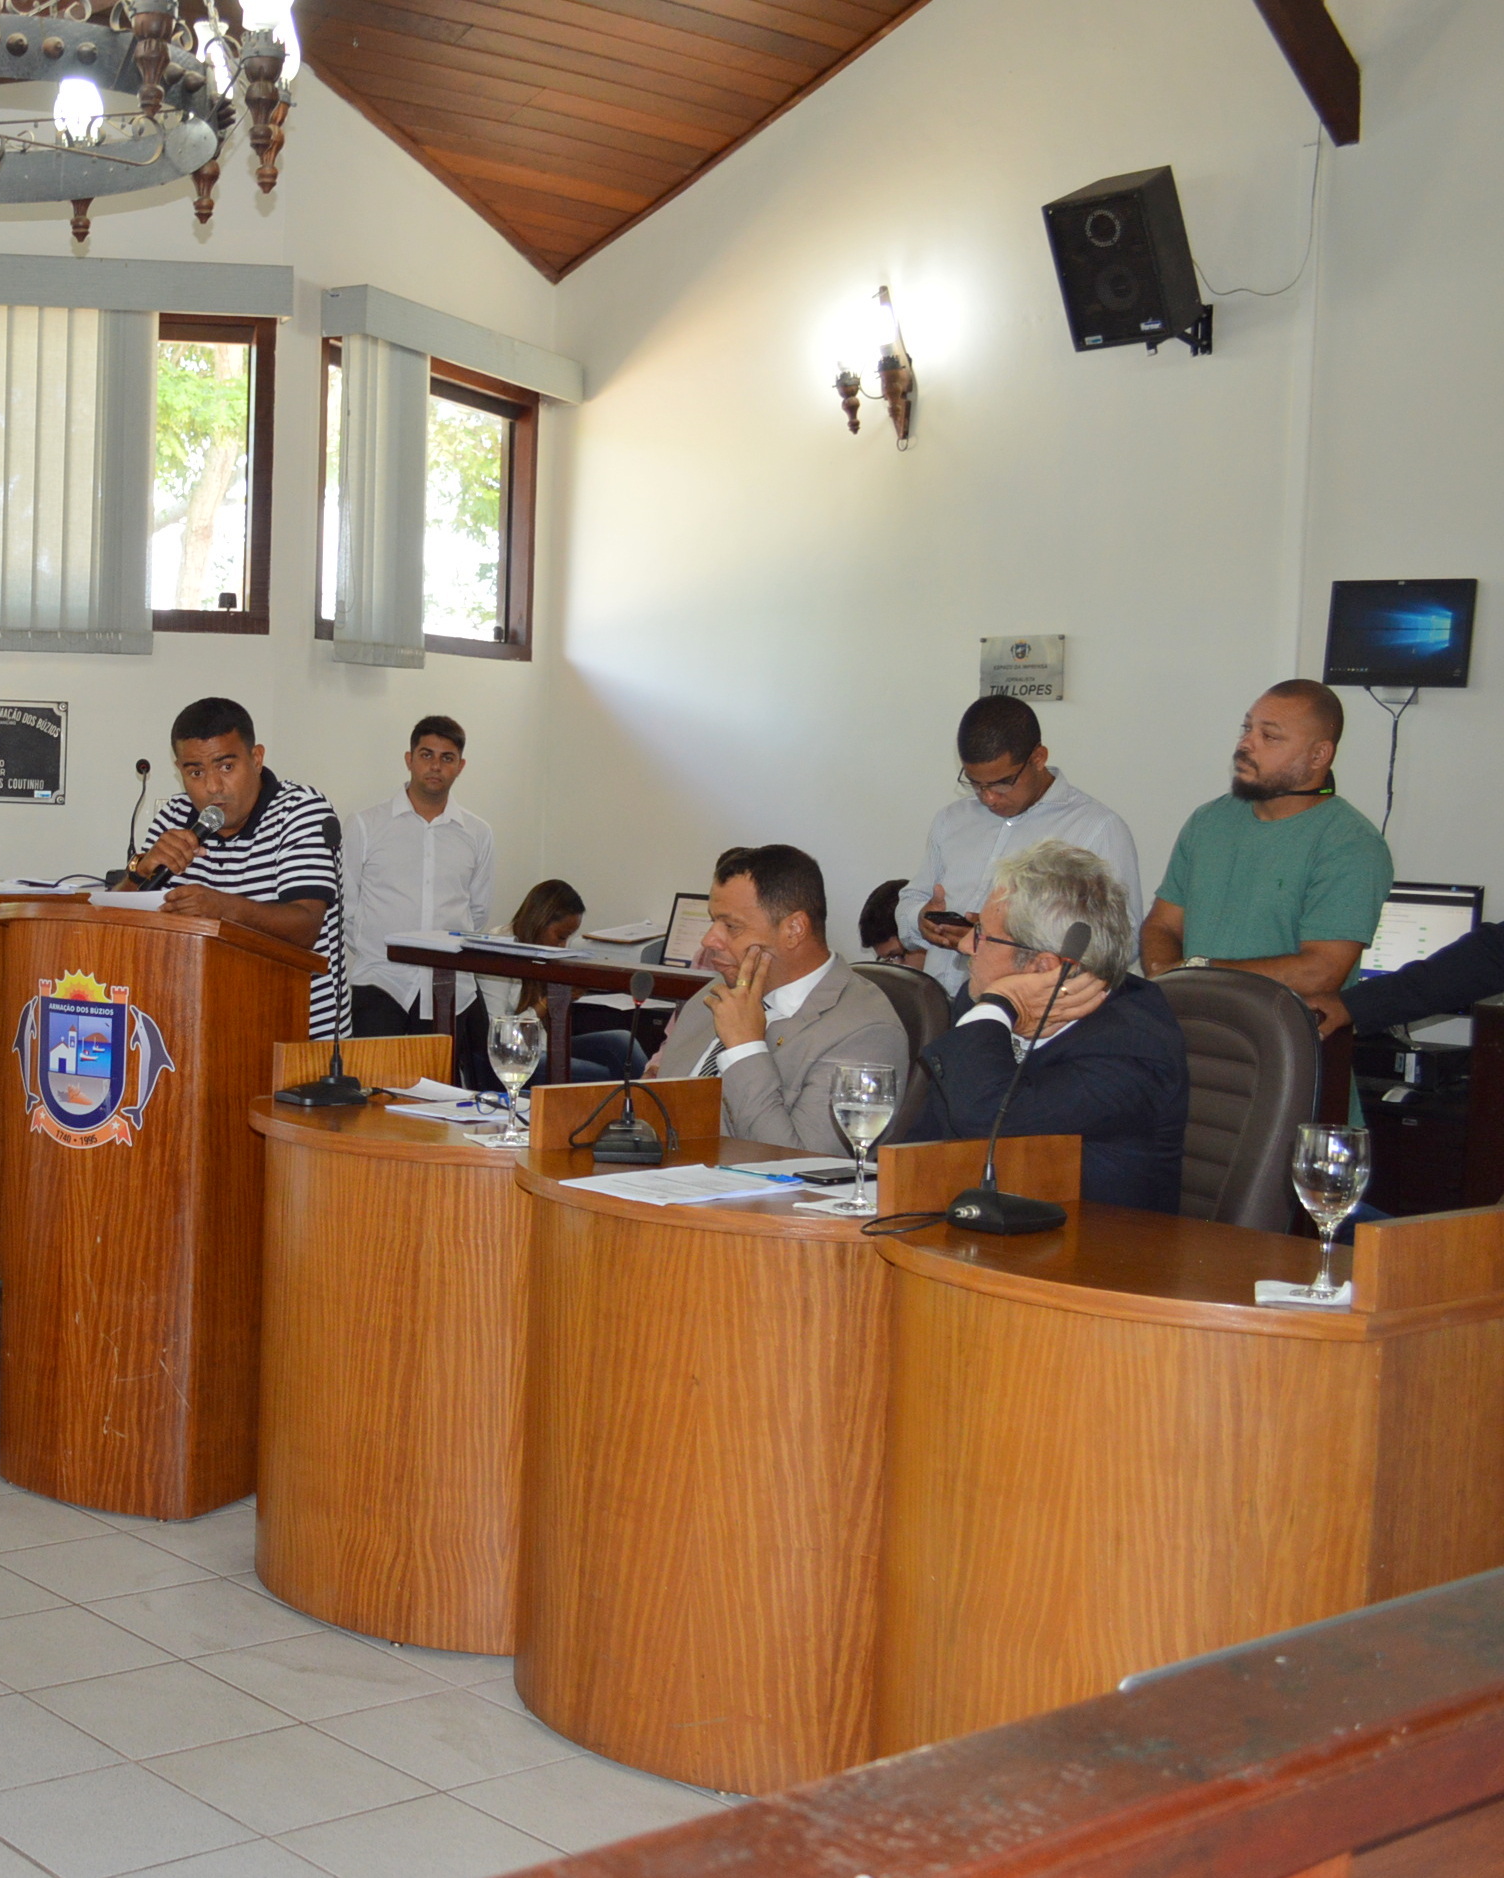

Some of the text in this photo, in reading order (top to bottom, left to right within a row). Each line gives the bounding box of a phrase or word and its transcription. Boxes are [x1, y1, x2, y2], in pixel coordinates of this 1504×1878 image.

[990, 684, 1052, 697] TIM LOPES
[21, 712, 37, 727] DOS
[36, 718, 61, 738] BÚZIOS
[7, 778, 45, 790] COUTINHO
[48, 1003, 75, 1012] ARMAÇÃO
[90, 1006, 114, 1016] BÚZIOS
[56, 1130, 98, 1145] 1740 1995
